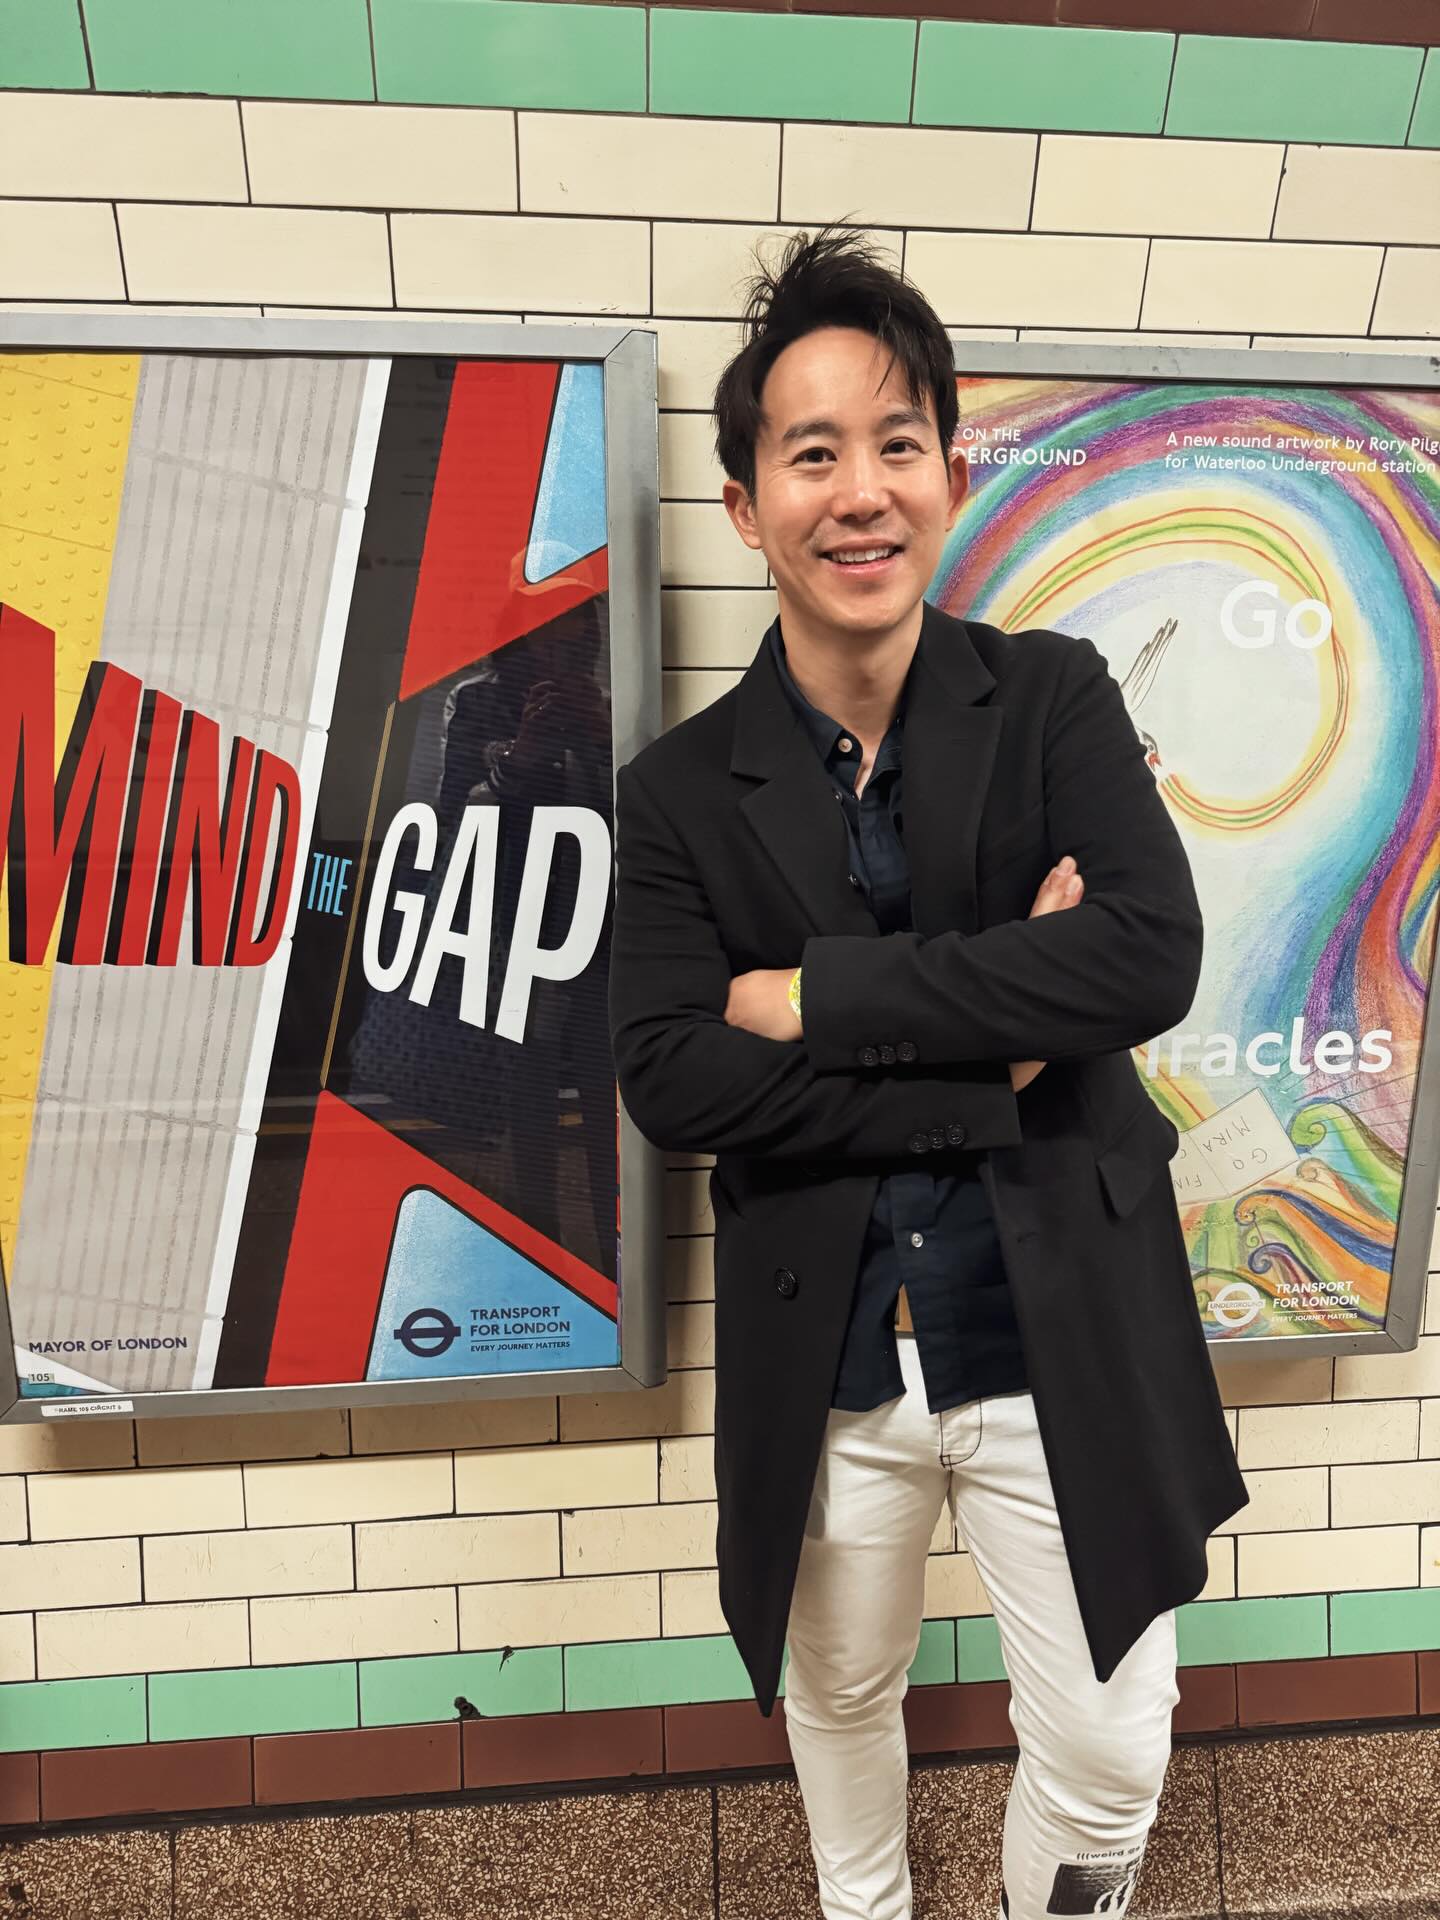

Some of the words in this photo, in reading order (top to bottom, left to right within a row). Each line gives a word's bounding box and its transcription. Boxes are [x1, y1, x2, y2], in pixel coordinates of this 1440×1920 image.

[963, 428, 986, 441] ON
[992, 429, 1021, 442] THE
[1166, 432, 1178, 446] A
[1183, 435, 1217, 447] new
[1222, 434, 1272, 448] sound
[1276, 436, 1340, 449] artwork
[1345, 436, 1365, 453] by
[1369, 437, 1405, 454] Rory
[1411, 437, 1440, 456] Pilg
[1165, 454, 1189, 468] for
[1194, 455, 1266, 470] Waterloo
[1271, 456, 1377, 475] Underground
[1381, 458, 1437, 473] station
[1220, 580, 1333, 649] Go
[0, 605, 302, 966] MIND
[307, 852, 353, 917] THE
[362, 802, 612, 1045] GAP
[1232, 1147, 1268, 1170] GO
[1276, 1281, 1354, 1294] TRANSPORT
[1272, 1299, 1298, 1309] FOR
[1301, 1295, 1361, 1307] LONDON
[470, 1306, 560, 1320] TRANSPORT
[470, 1325, 500, 1337] FOR
[504, 1321, 571, 1335] LONDON
[29, 1341, 85, 1353] MAYOR
[91, 1340, 113, 1351] OF
[118, 1337, 188, 1350] LONDON
[497, 1343, 533, 1351] JOURNEY
[31, 1373, 50, 1382] 105
